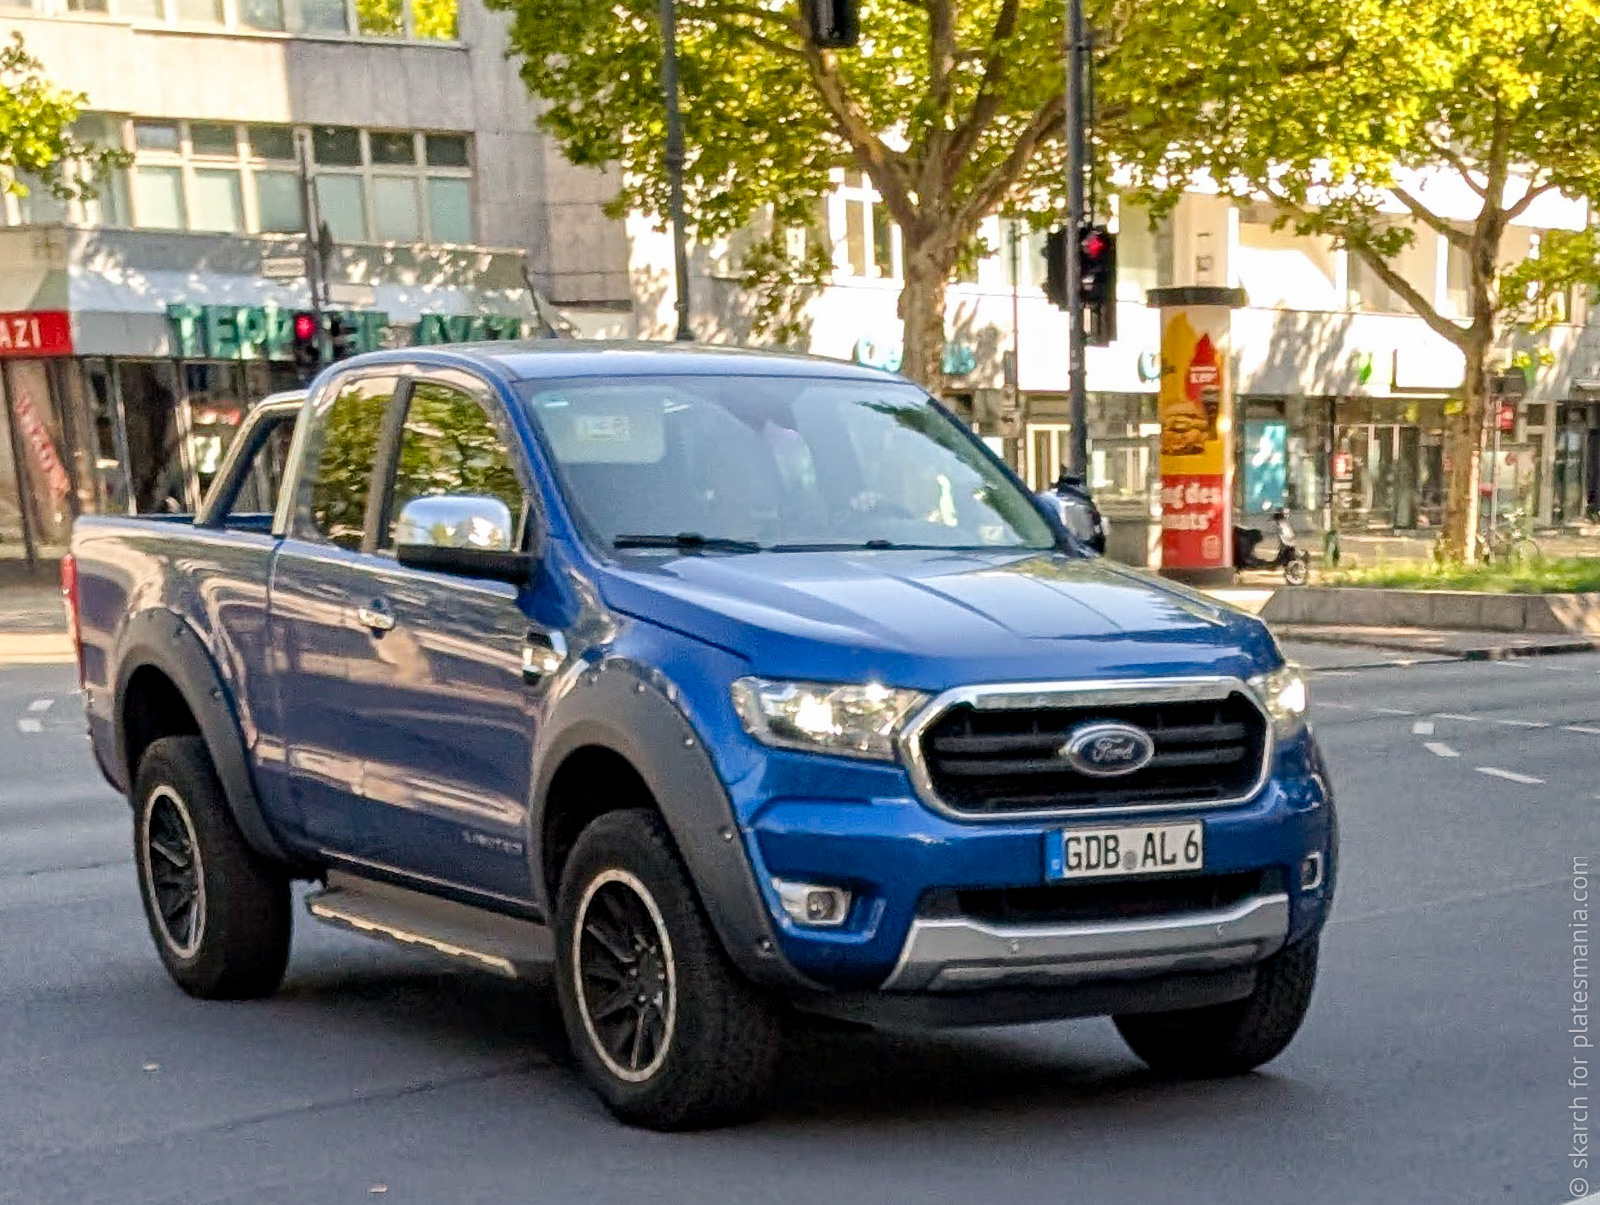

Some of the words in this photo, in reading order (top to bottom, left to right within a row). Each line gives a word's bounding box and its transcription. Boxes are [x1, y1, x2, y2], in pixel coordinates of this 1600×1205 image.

[1065, 834, 1120, 872] GDB
[1142, 831, 1176, 867] AL
[1184, 829, 1199, 864] 6
